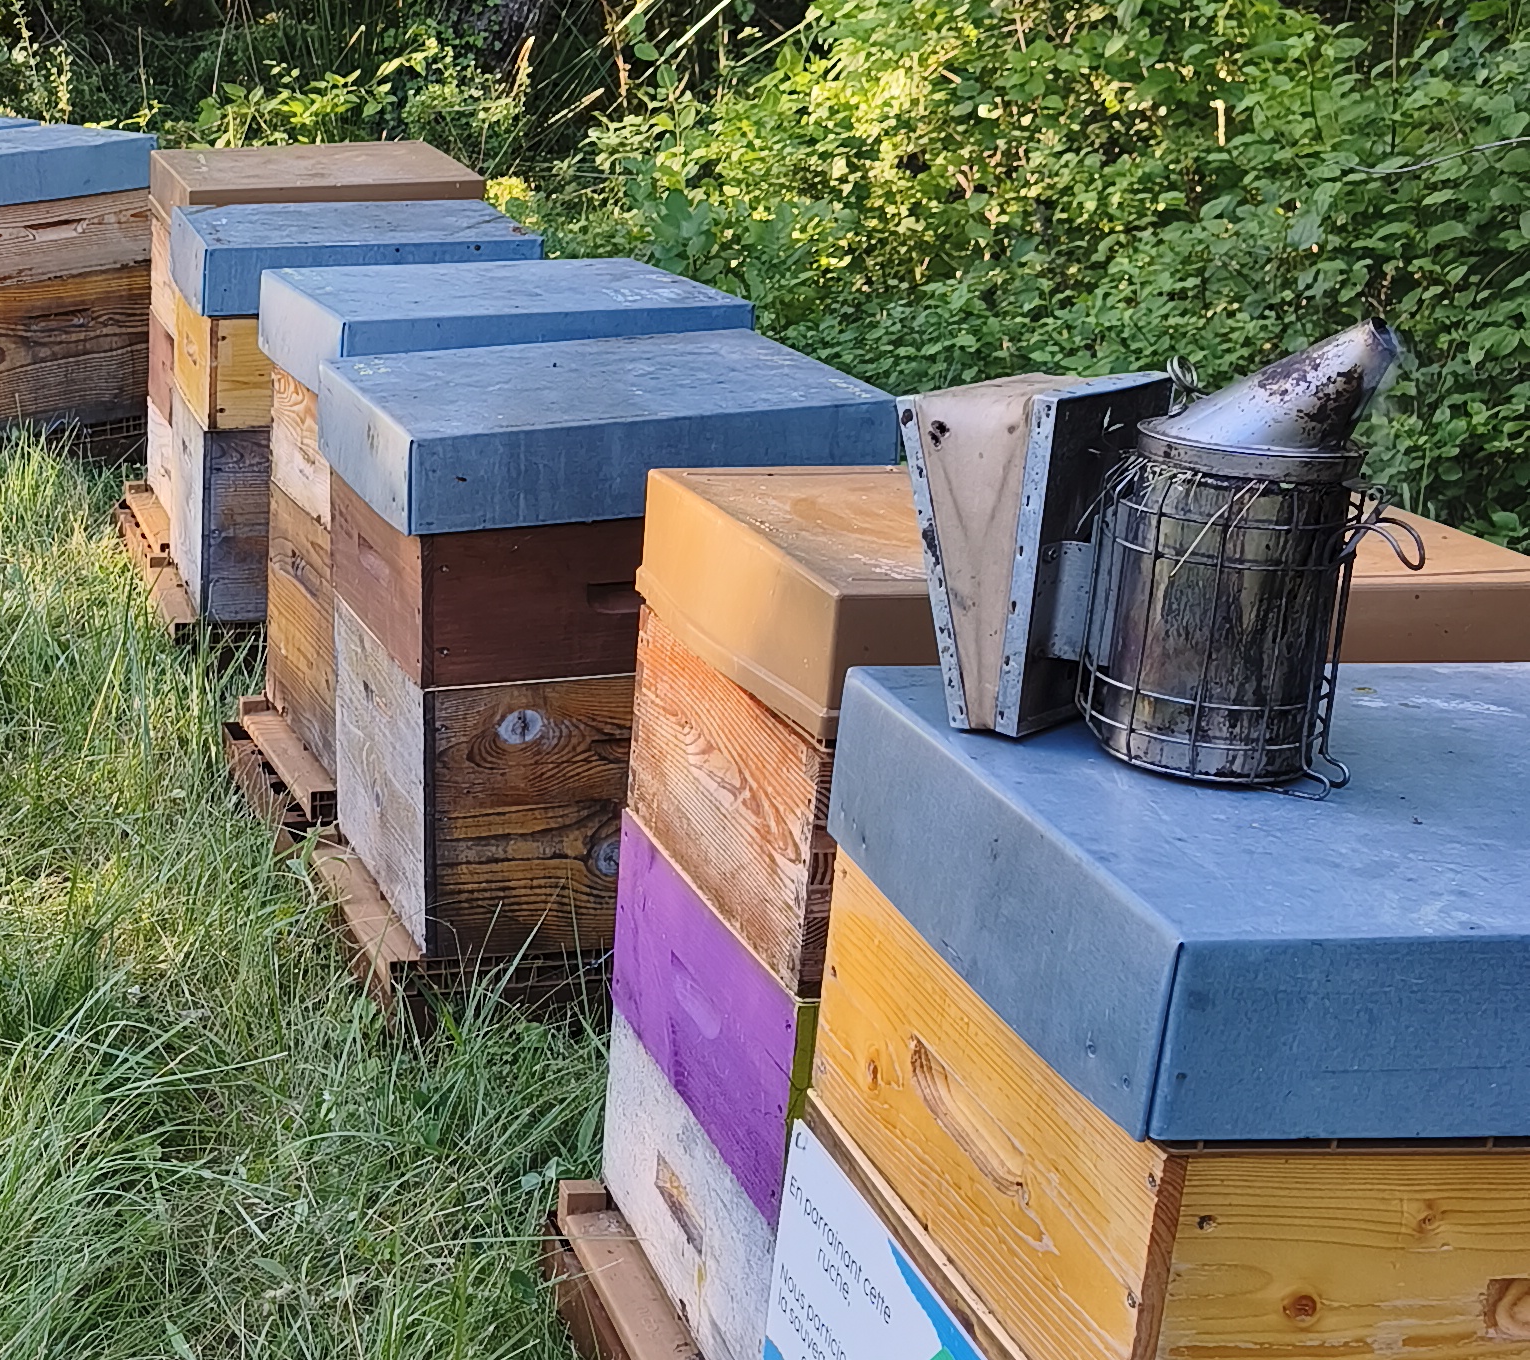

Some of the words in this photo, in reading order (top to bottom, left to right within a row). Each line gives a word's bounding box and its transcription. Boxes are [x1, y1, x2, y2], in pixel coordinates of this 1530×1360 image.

[789, 1175, 803, 1206] En
[804, 1197, 862, 1284] parrainant
[864, 1278, 891, 1324] cette
[778, 1287, 788, 1314] la
[780, 1262, 805, 1310] Nous
[817, 1247, 851, 1308] ruche,
